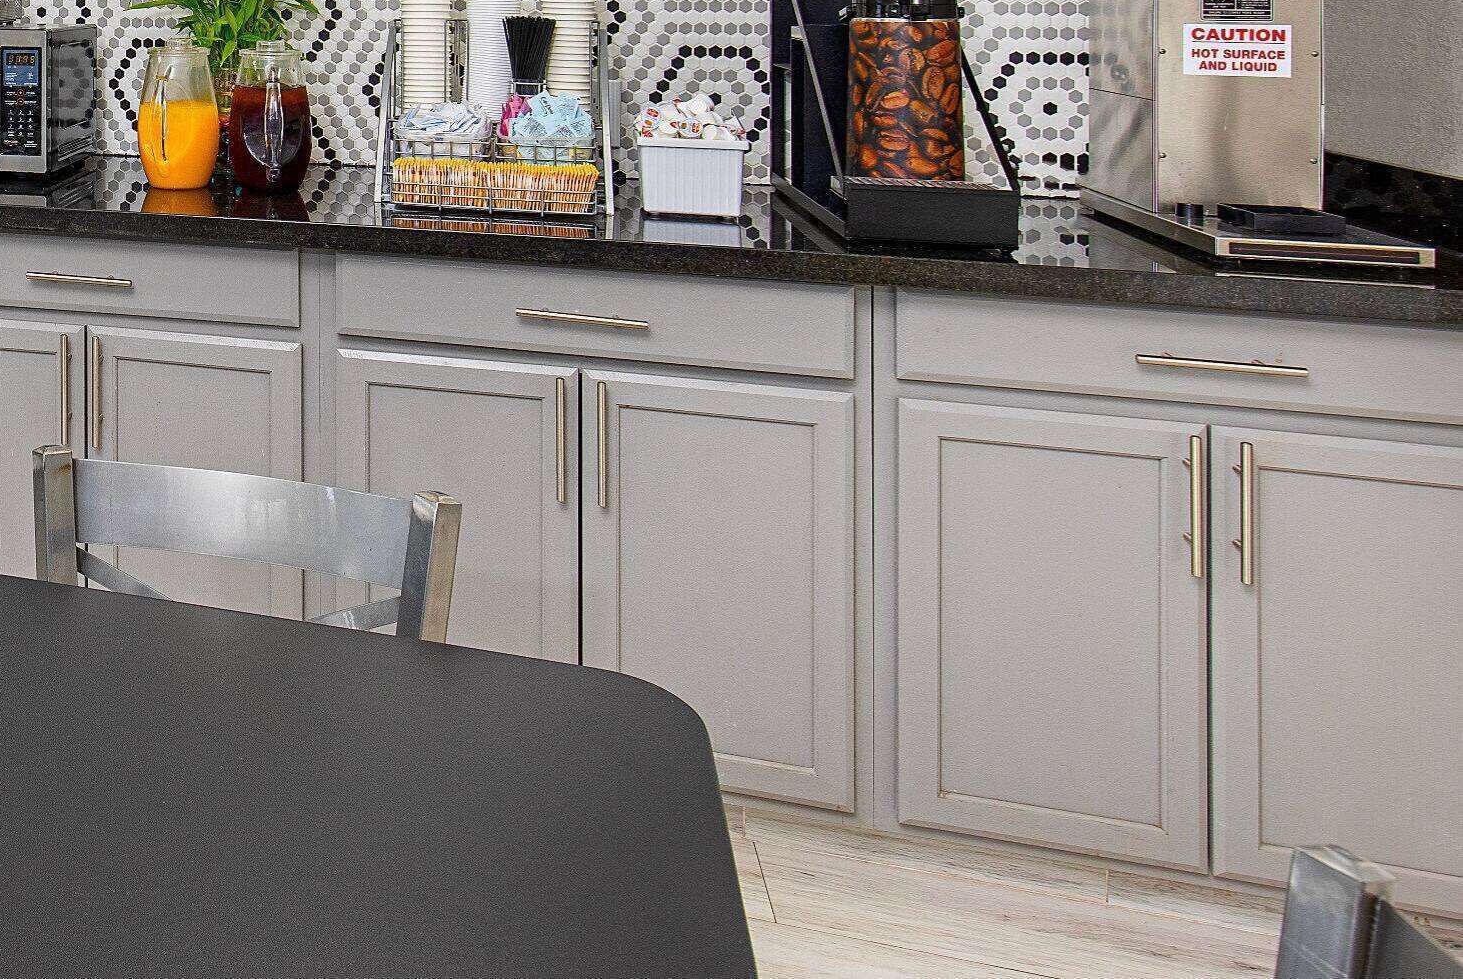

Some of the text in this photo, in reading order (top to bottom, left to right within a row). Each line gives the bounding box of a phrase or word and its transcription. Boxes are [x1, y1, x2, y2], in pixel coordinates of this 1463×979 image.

[1191, 27, 1286, 41] CAUTION
[1191, 48, 1286, 60] HOT SURFACE
[1199, 61, 1278, 72] AND LIQUID
